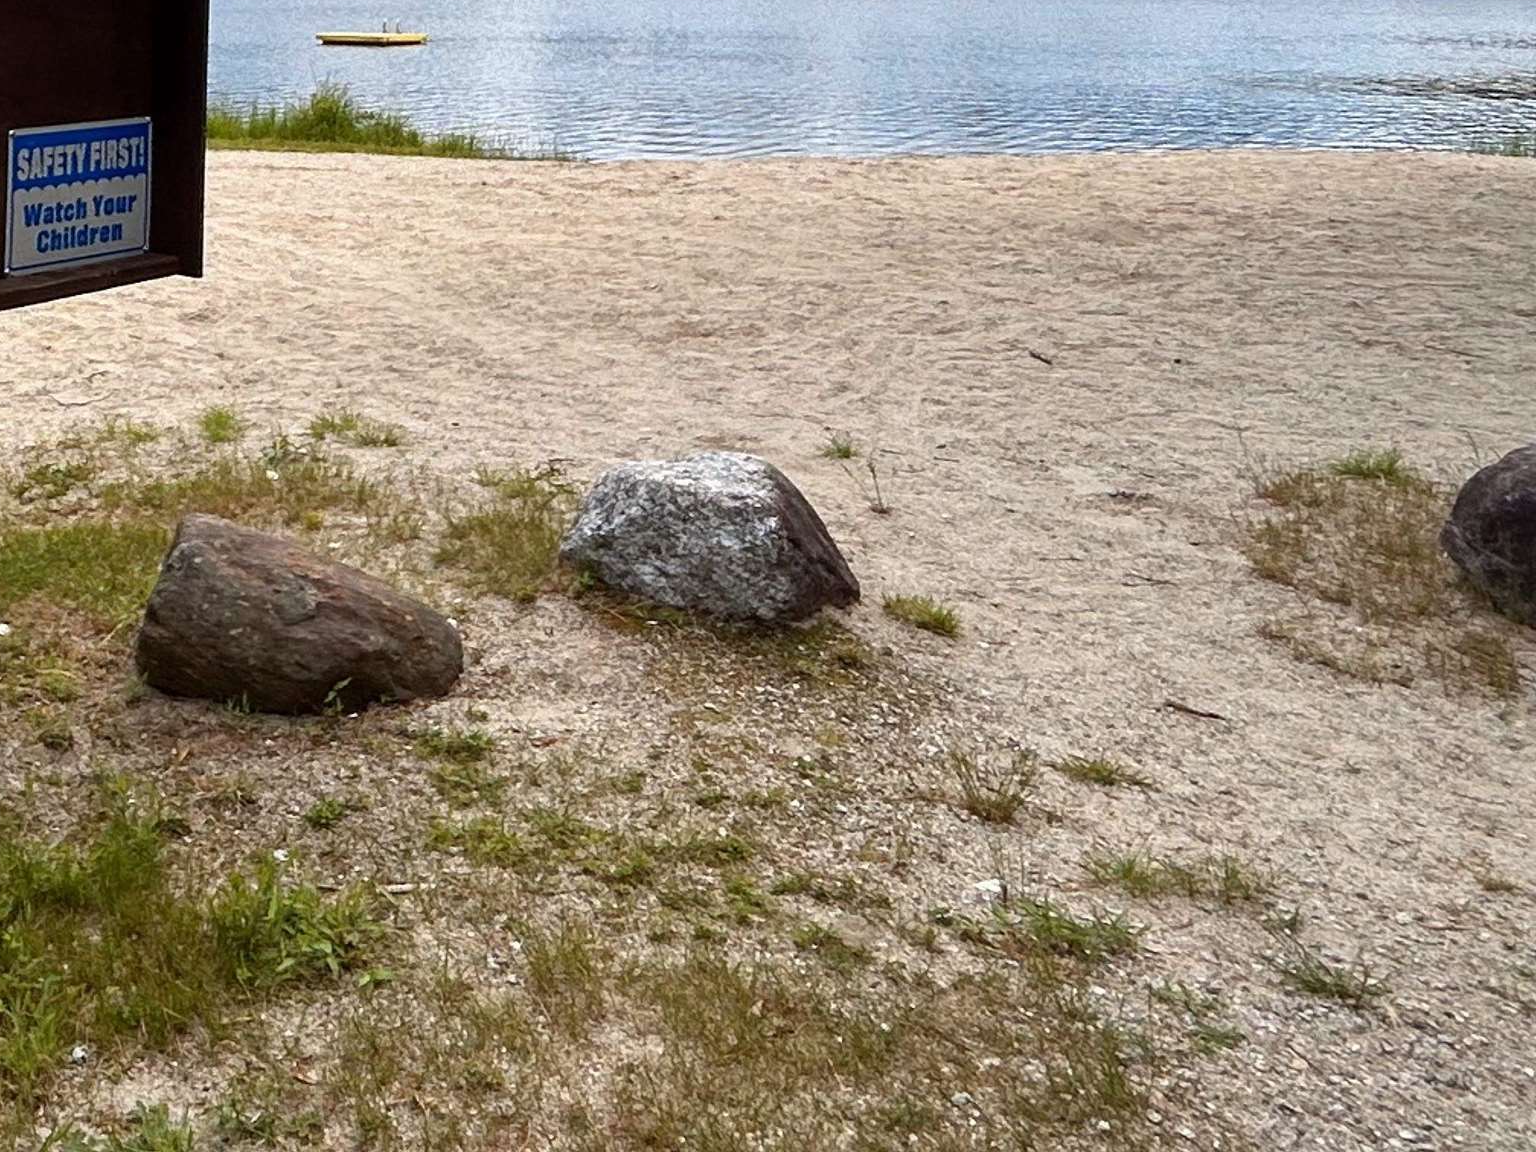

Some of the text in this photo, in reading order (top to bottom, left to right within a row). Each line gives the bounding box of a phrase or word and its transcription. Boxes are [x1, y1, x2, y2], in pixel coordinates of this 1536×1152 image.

[17, 135, 145, 181] SAFETY FIRST!
[23, 194, 138, 227] Watch Your
[36, 223, 123, 254] Children
